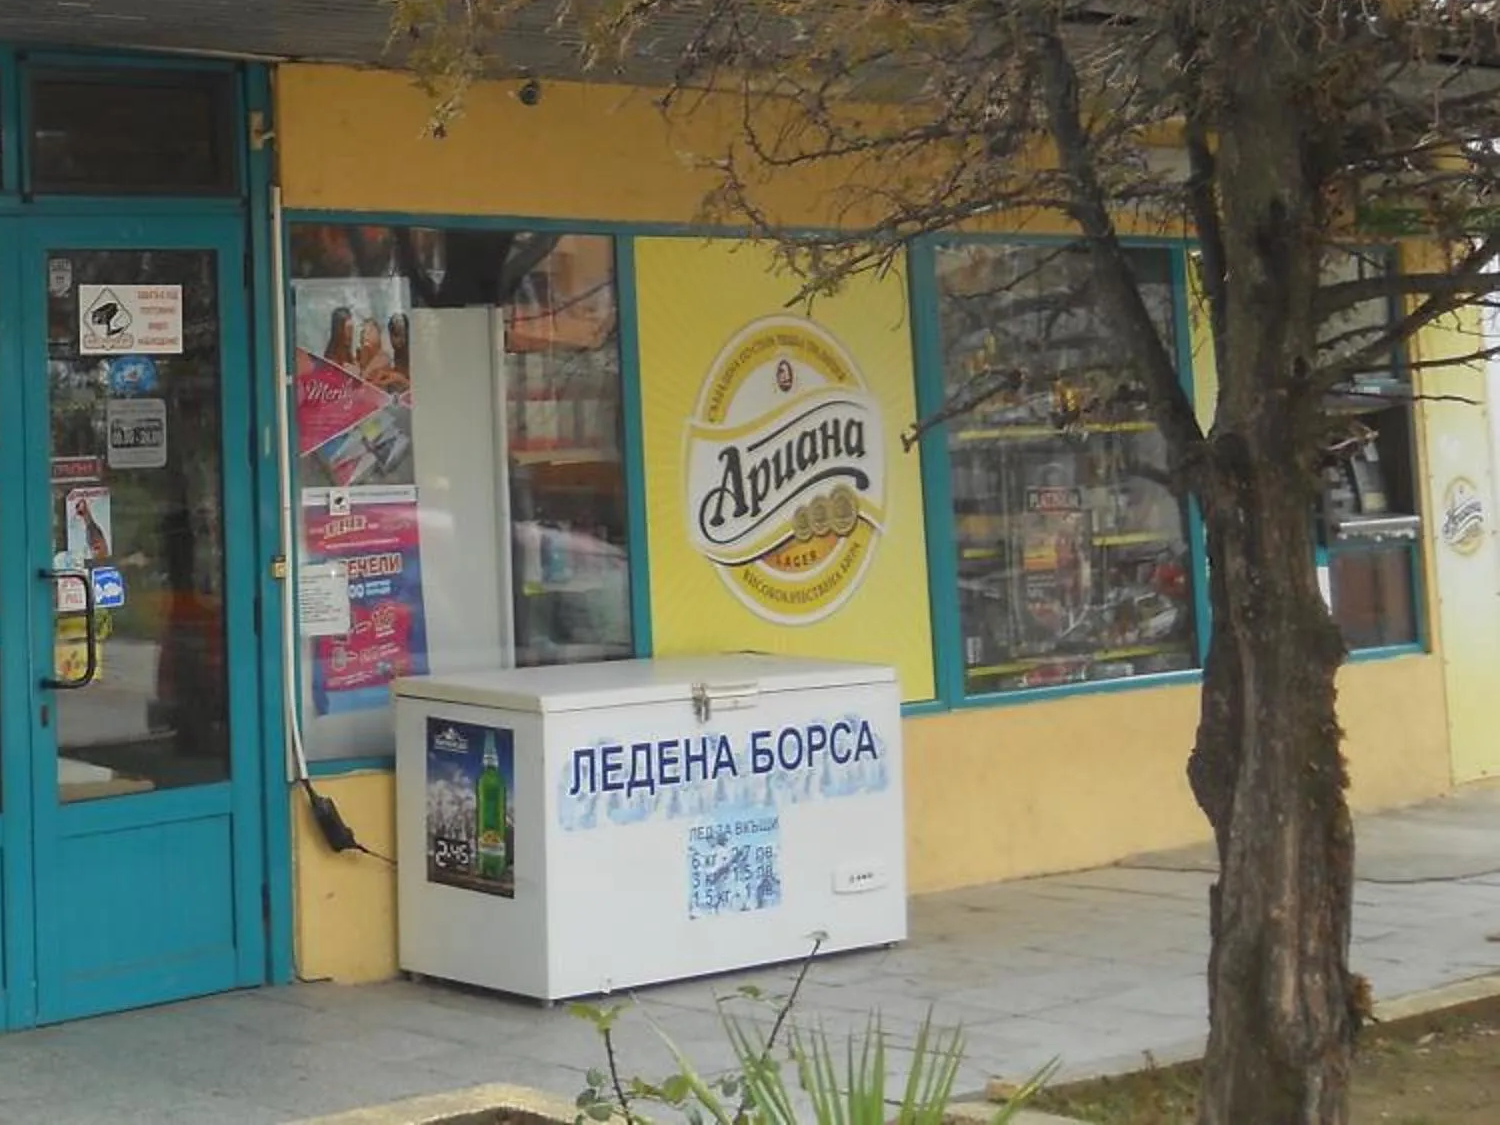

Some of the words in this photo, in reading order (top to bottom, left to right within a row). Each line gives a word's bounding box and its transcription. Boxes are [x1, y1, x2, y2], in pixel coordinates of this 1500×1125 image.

[699, 416, 867, 540] Ариана
[340, 553, 403, 579] ЕЧЕЛИ
[569, 734, 739, 798] ЛЕДЕНА
[751, 720, 878, 775] БОРСА
